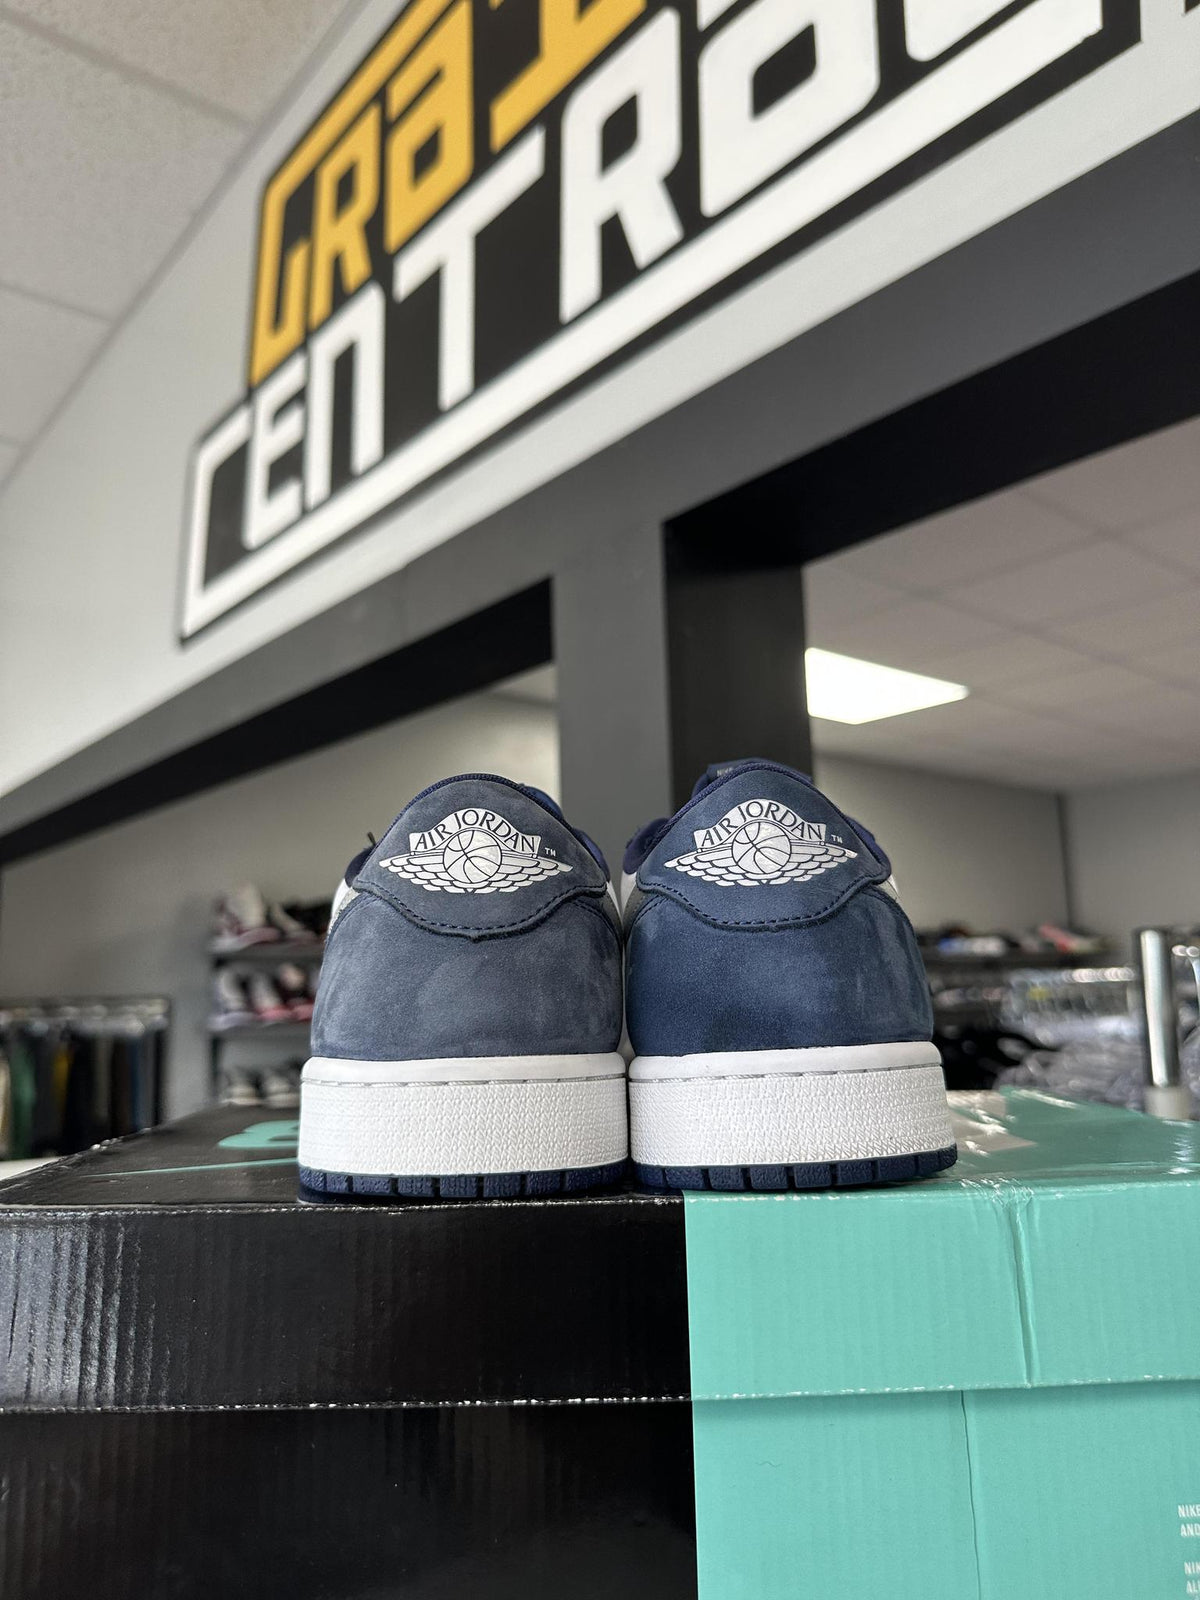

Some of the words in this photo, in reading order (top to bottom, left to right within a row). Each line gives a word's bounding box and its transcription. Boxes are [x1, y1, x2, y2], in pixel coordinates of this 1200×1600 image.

[415, 823, 453, 850] AIR
[454, 809, 536, 853] JORDAN
[701, 817, 738, 847] AIR
[737, 801, 822, 840] JORDAN
[1186, 1580, 1200, 1595] AL
